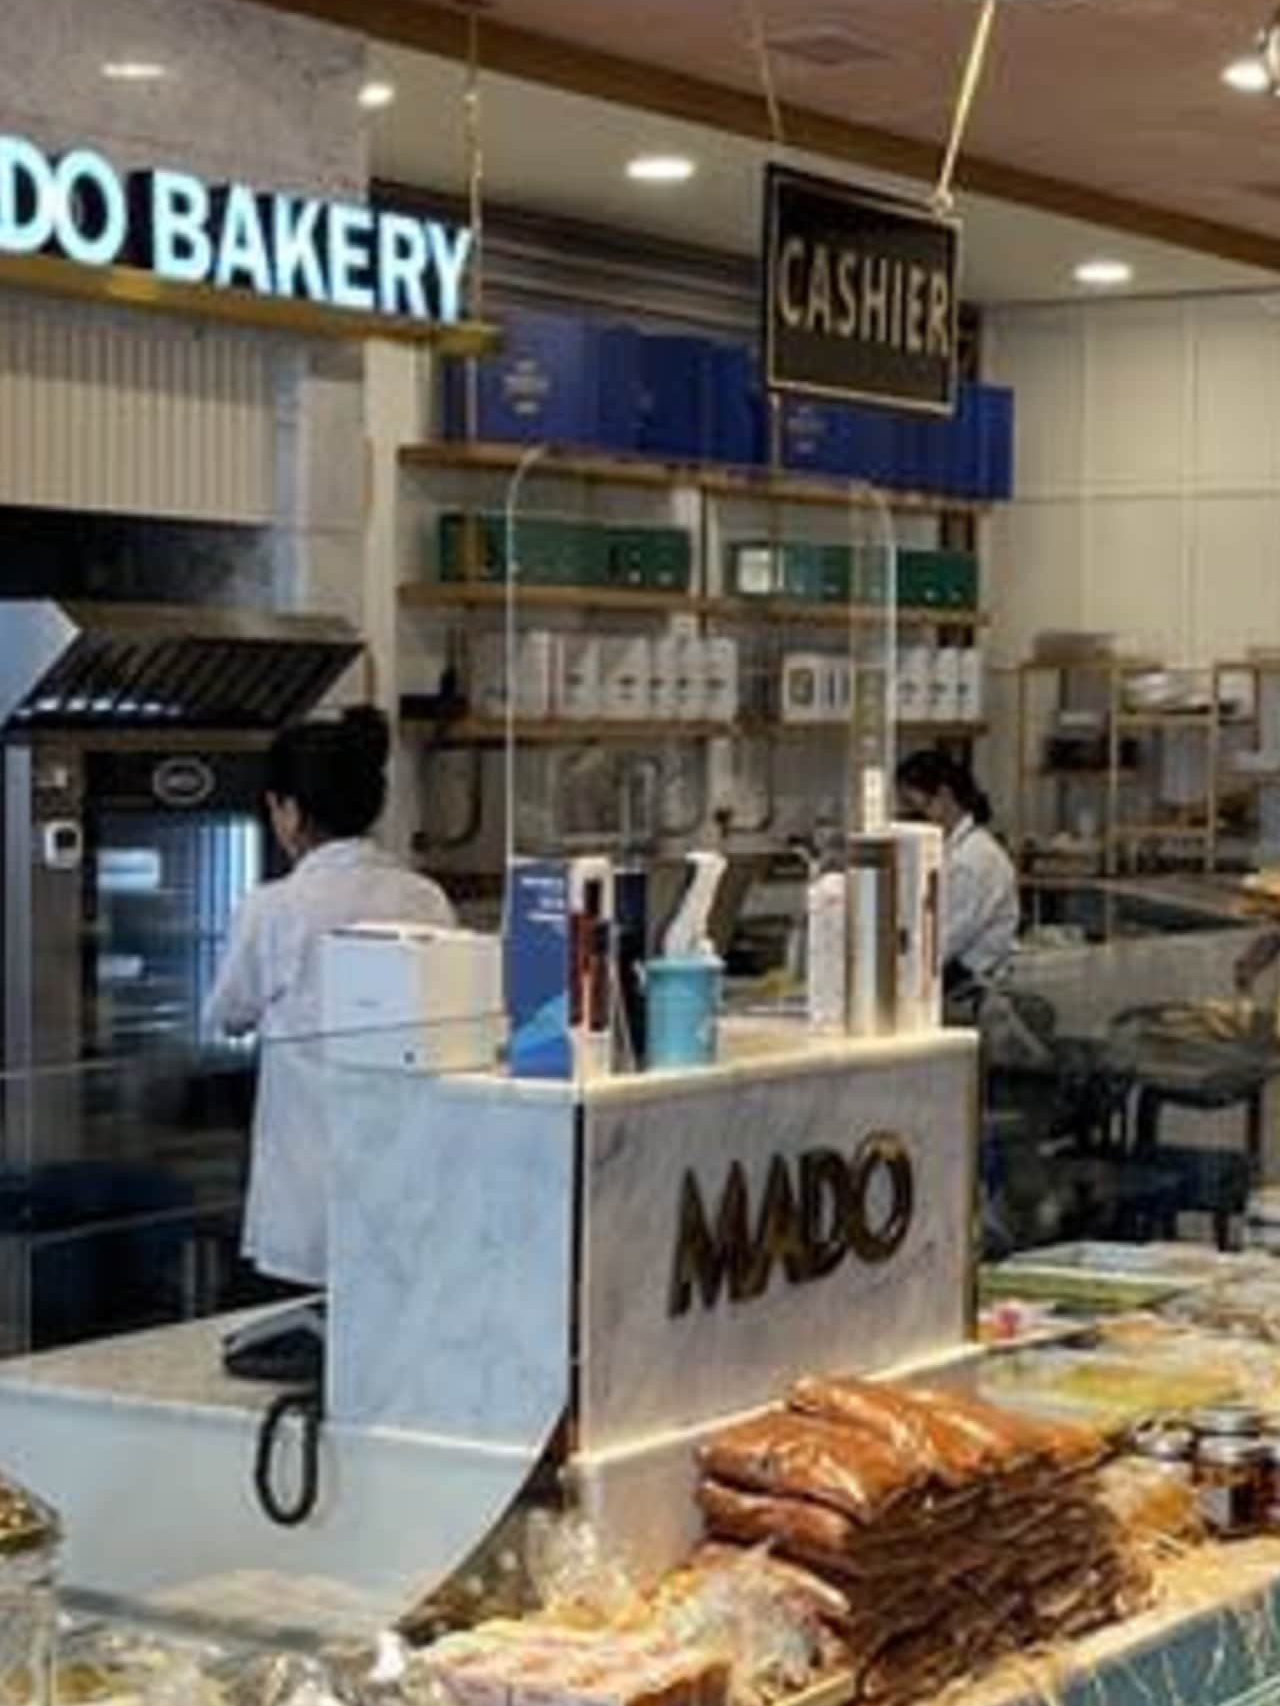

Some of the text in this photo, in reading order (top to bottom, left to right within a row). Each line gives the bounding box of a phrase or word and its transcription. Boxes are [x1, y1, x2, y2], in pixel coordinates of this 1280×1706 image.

[150, 169, 474, 322] BAKERY
[777, 237, 951, 358] CASHIER
[666, 1130, 914, 1320] MADO
